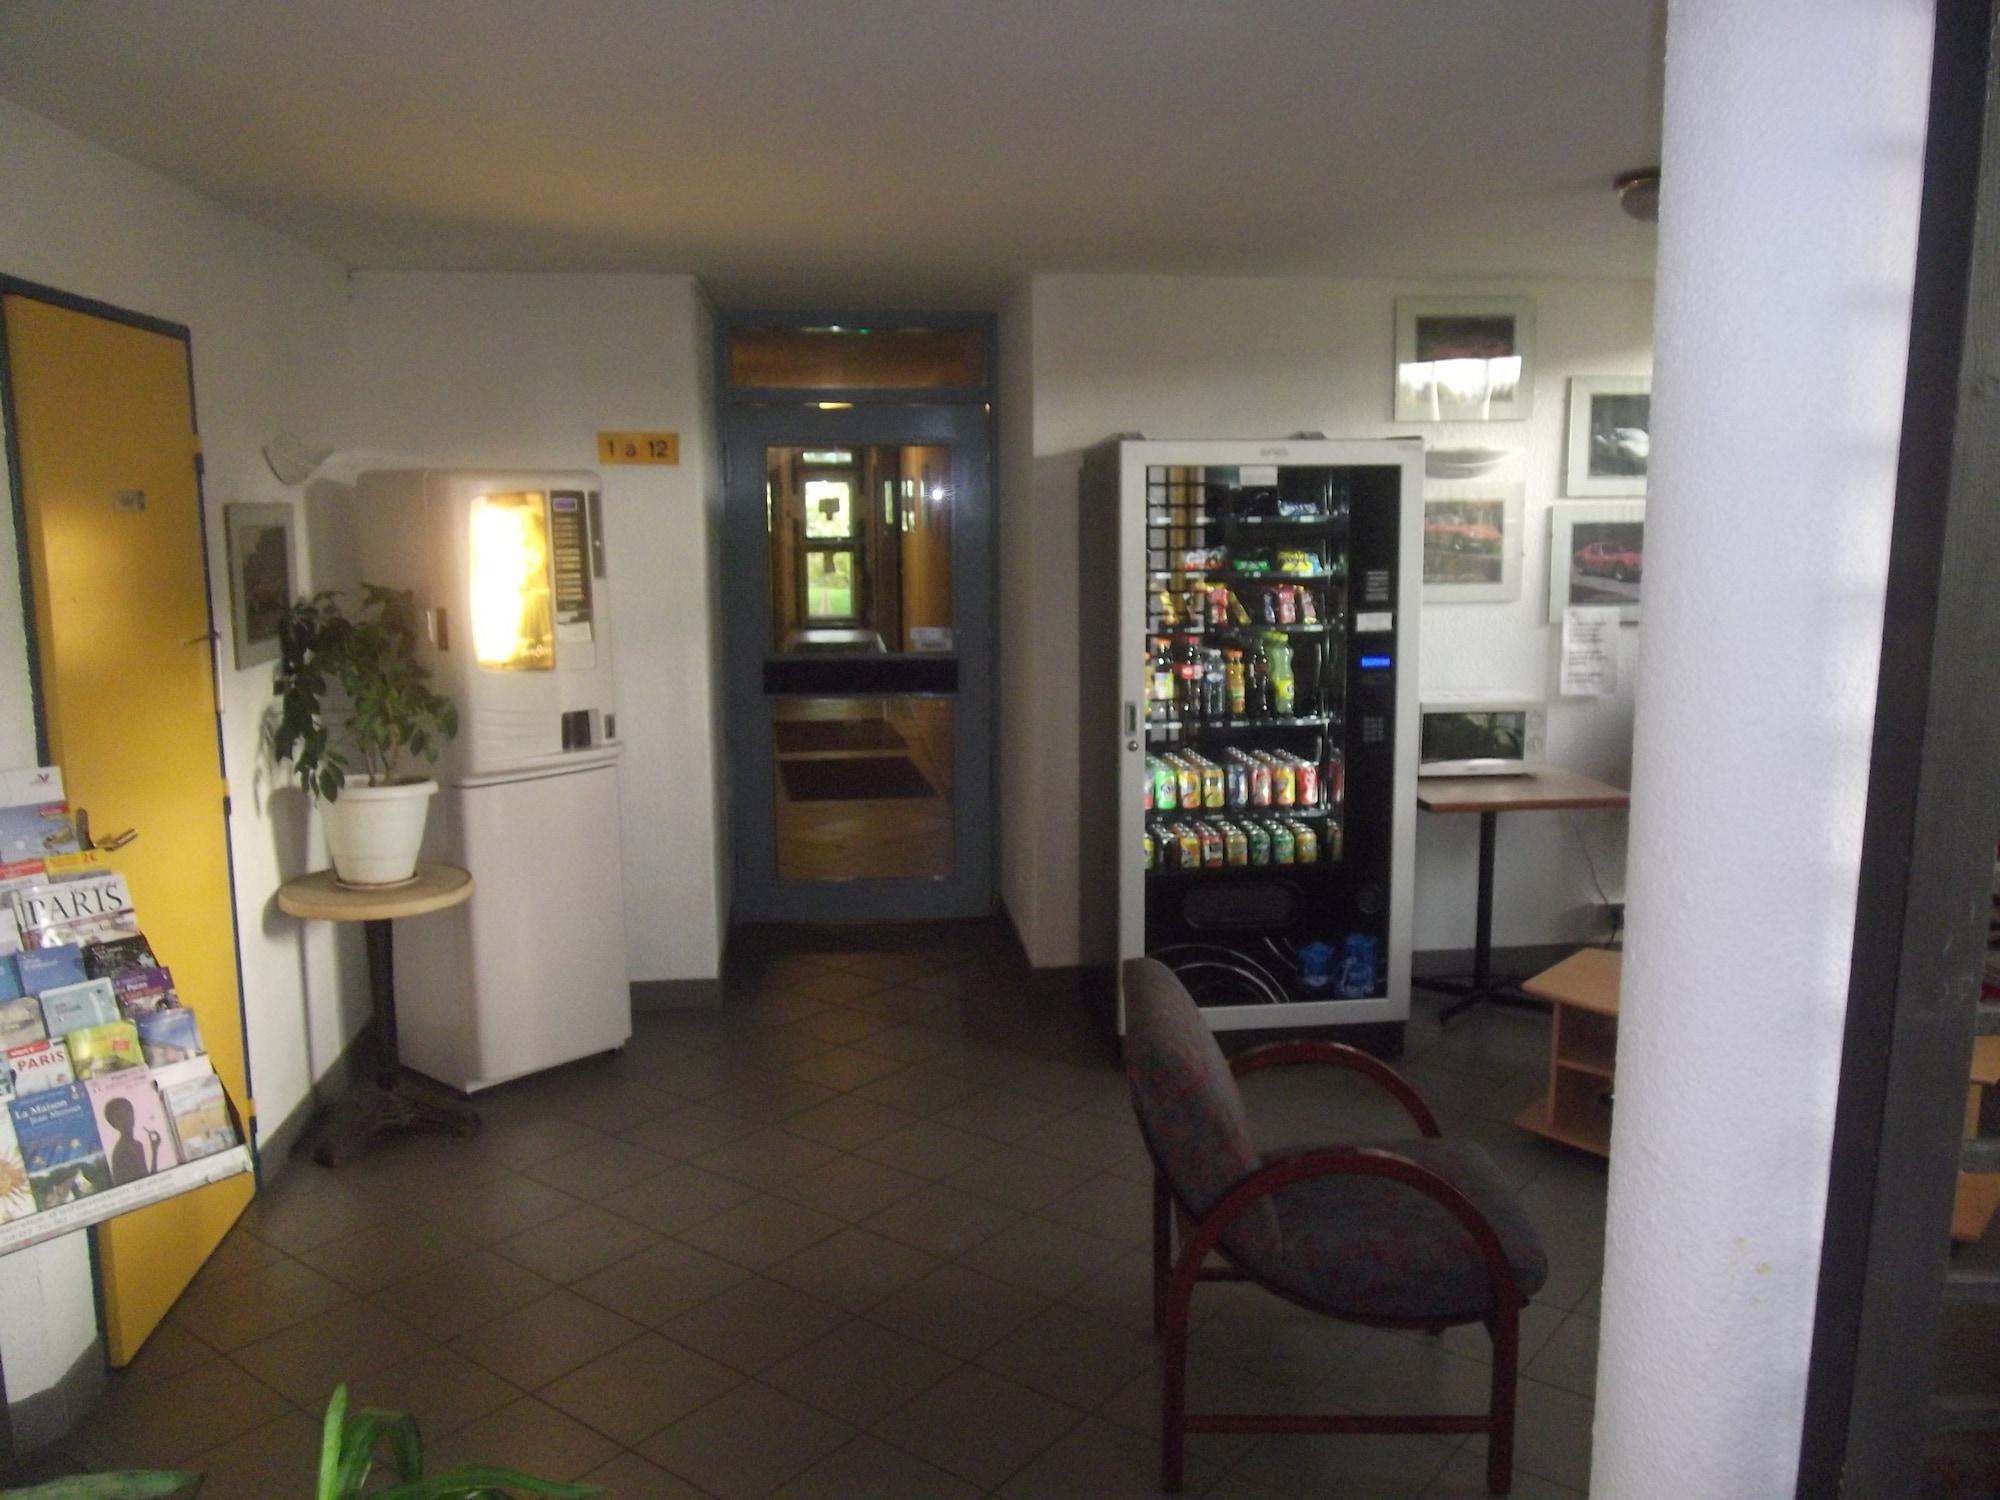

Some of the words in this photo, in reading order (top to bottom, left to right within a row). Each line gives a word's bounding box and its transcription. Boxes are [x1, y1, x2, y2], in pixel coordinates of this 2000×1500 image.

[607, 439, 614, 456] 1
[647, 439, 668, 458] 12
[24, 881, 123, 924] PARIS
[17, 1050, 66, 1071] PARIS
[14, 1107, 30, 1120] La
[30, 1099, 69, 1116] Maison
